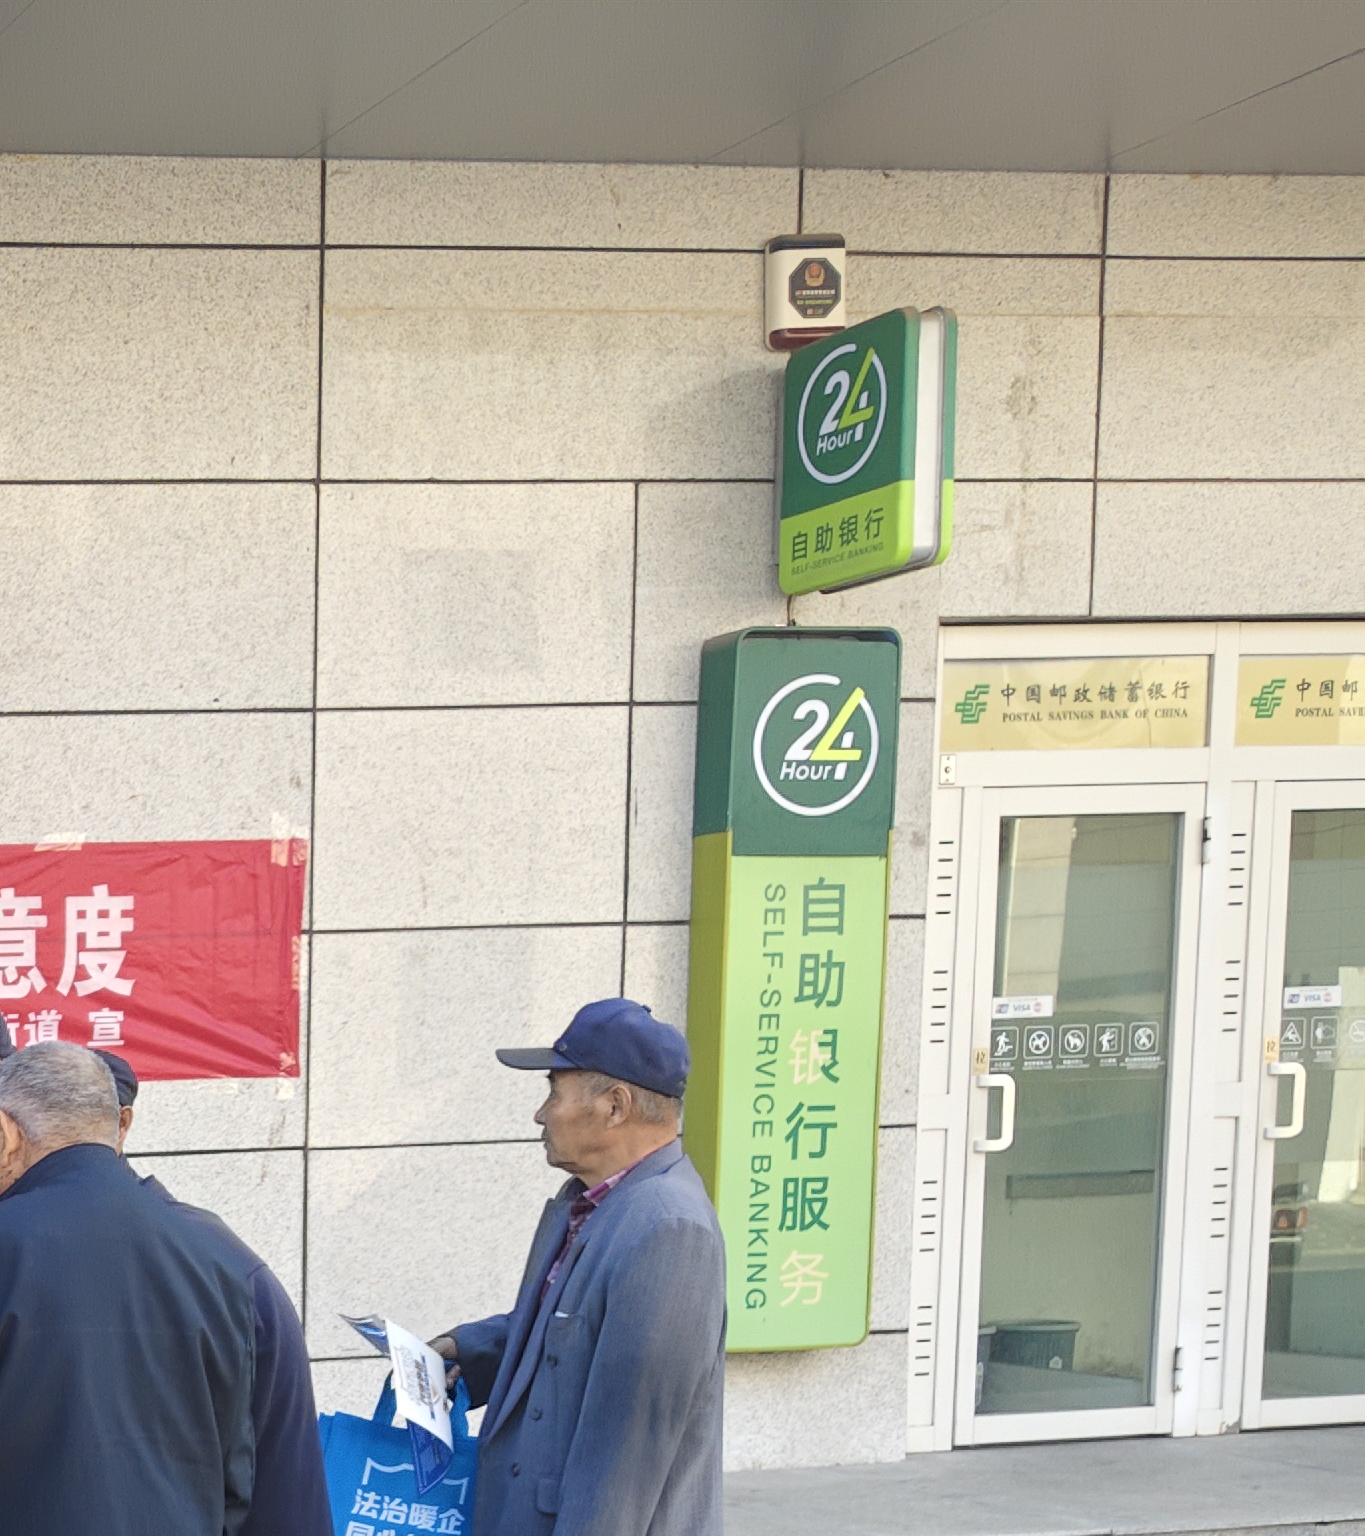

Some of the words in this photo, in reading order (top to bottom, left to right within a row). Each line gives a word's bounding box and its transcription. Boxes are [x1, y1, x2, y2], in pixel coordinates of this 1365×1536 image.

[819, 346, 875, 441] 24
[816, 431, 852, 456] Hour
[791, 507, 885, 563] 自助银行
[791, 555, 846, 576] SELF-SERVICE
[847, 541, 885, 561] BANKING
[1000, 680, 1190, 707] 中国邮政储蓄银行
[1296, 678, 1358, 702] 中国邮
[1002, 712, 1044, 723] POSTAL
[1048, 710, 1095, 721] SAVINGS
[1100, 709, 1130, 720] BANK
[1135, 709, 1149, 719] OF
[1154, 707, 1188, 718] CHINA
[1295, 707, 1334, 718] POSTAL
[784, 686, 866, 781] 24
[779, 761, 833, 781] Hour
[87, 1008, 125, 1047] 宣
[752, 882, 787, 1140] SELF-SERVICE
[778, 876, 847, 1308] 自助银行服务
[744, 1154, 774, 1311] BANKING
[351, 1488, 467, 1536] 法治暖企
